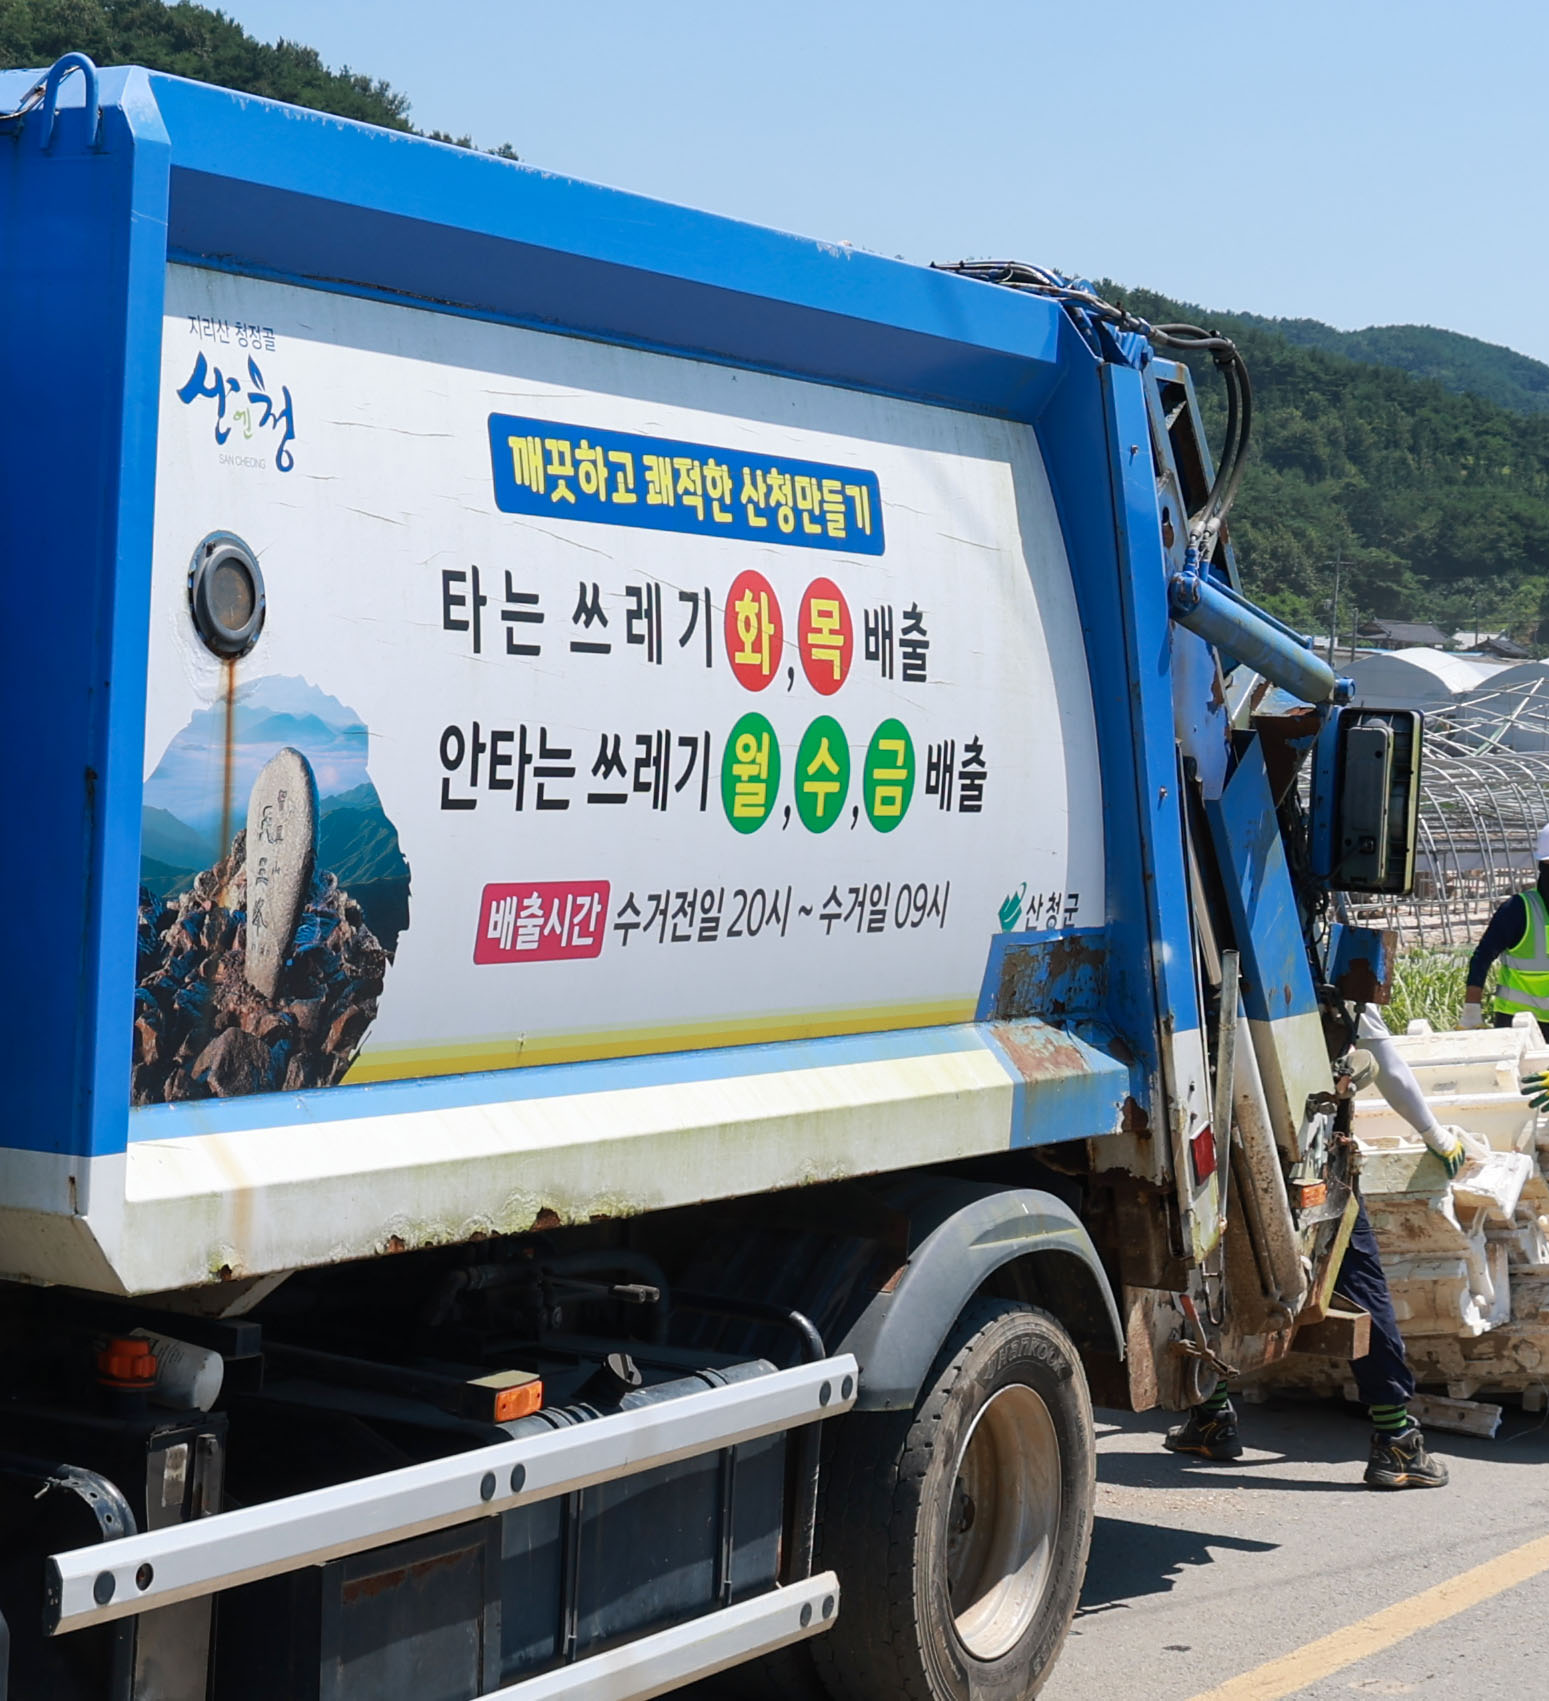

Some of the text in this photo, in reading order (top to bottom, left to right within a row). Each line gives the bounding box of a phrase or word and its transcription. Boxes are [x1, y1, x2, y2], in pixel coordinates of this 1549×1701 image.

[187, 315, 277, 352] 지리산 청정골
[507, 434, 872, 539] 깨끗하고 쾌적한 산청만들기
[441, 564, 545, 657] 타는
[569, 581, 713, 669] 쓰레기
[863, 600, 931, 683] 배출
[438, 720, 577, 812] 안타는
[586, 728, 711, 812] 쓰레기
[924, 733, 989, 814] 배출
[486, 890, 603, 951] 배출시간
[612, 885, 726, 947] 수거전일
[726, 884, 793, 938] 20시
[818, 880, 892, 936] 수거일
[894, 880, 951, 930] 09시
[1024, 890, 1080, 932] 산청군
